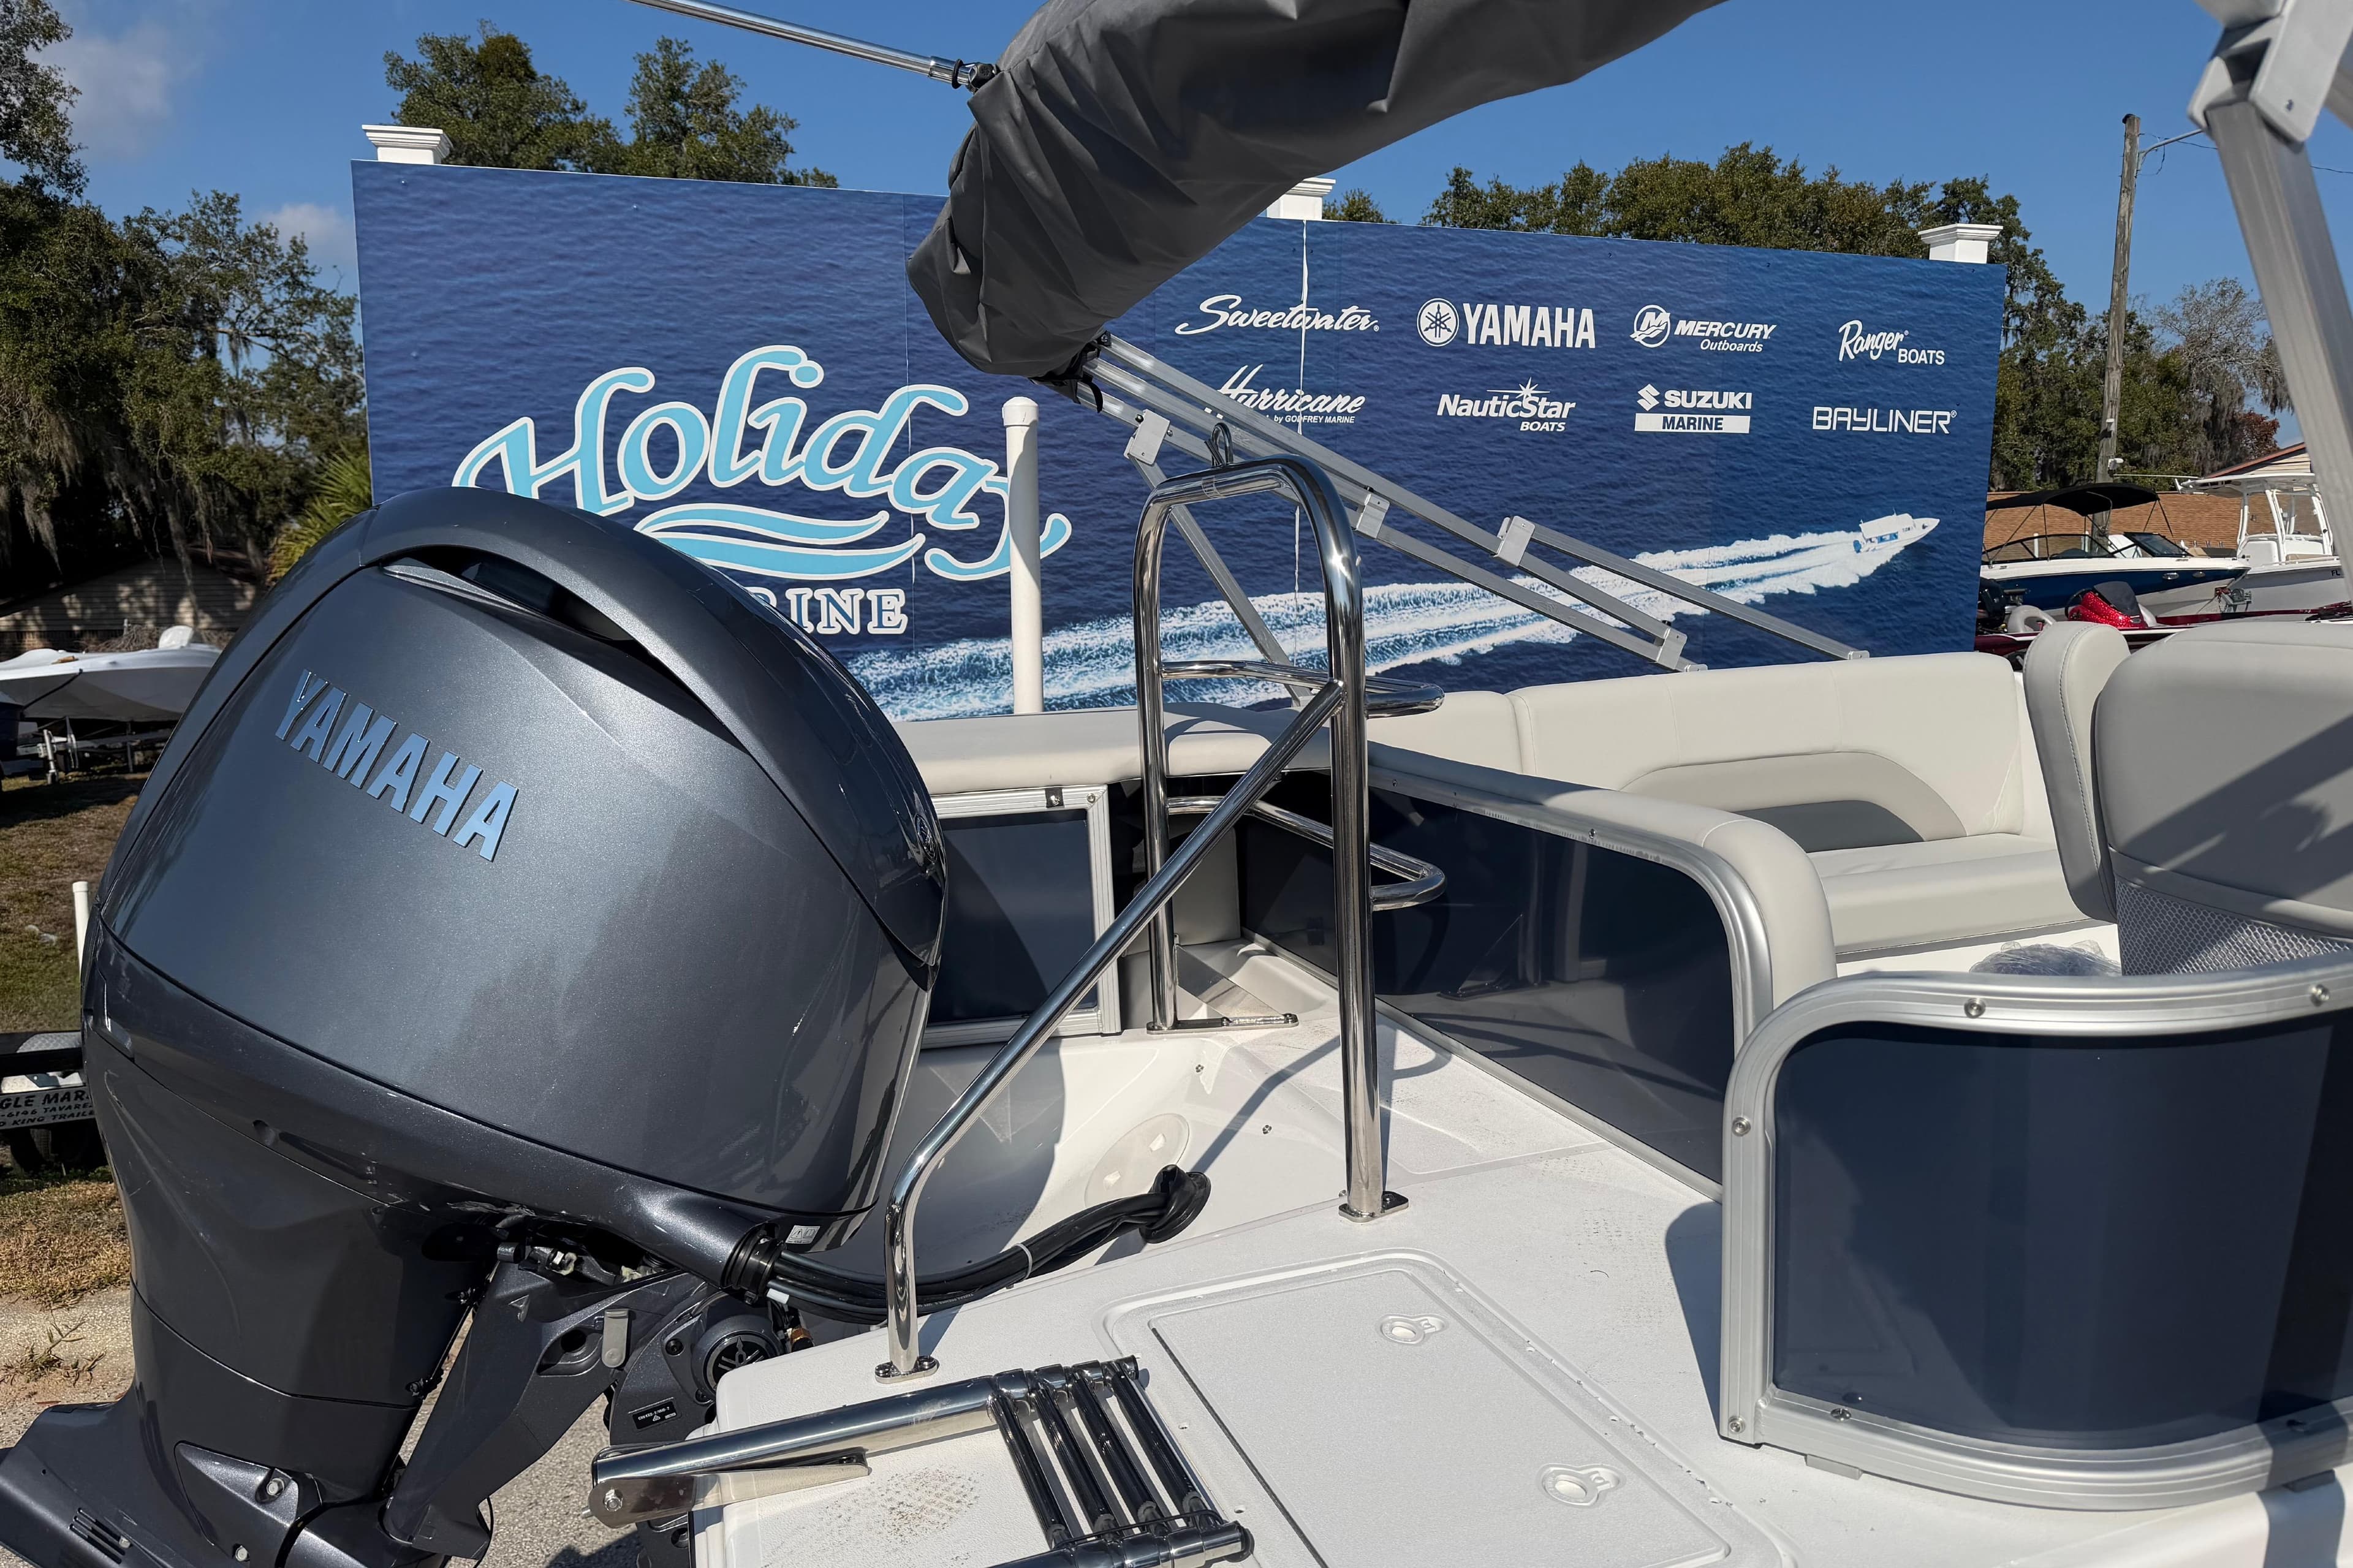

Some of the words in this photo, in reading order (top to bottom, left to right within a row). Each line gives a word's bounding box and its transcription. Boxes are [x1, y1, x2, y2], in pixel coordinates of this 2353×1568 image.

[1175, 295, 1378, 335] Sweetwater
[1463, 303, 1596, 348] YAMAHA
[1674, 320, 1776, 339] MERCURY
[1700, 338, 1763, 352] Outboards
[1838, 320, 1904, 362] Ranger
[1898, 348, 1945, 365] BOATS
[1204, 363, 1365, 420] Hurricane
[1664, 390, 1752, 409] SUZUKI
[1437, 394, 1576, 419] NauticStar
[1274, 415, 1283, 423] by
[1520, 421, 1566, 431] BOATS
[1662, 416, 1724, 430] MARINE
[1813, 406, 1950, 434] BAYLINER
[452, 344, 1072, 581] Holiday
[275, 668, 519, 863] YAMAHA
[42, 1090, 90, 1105] MAR
